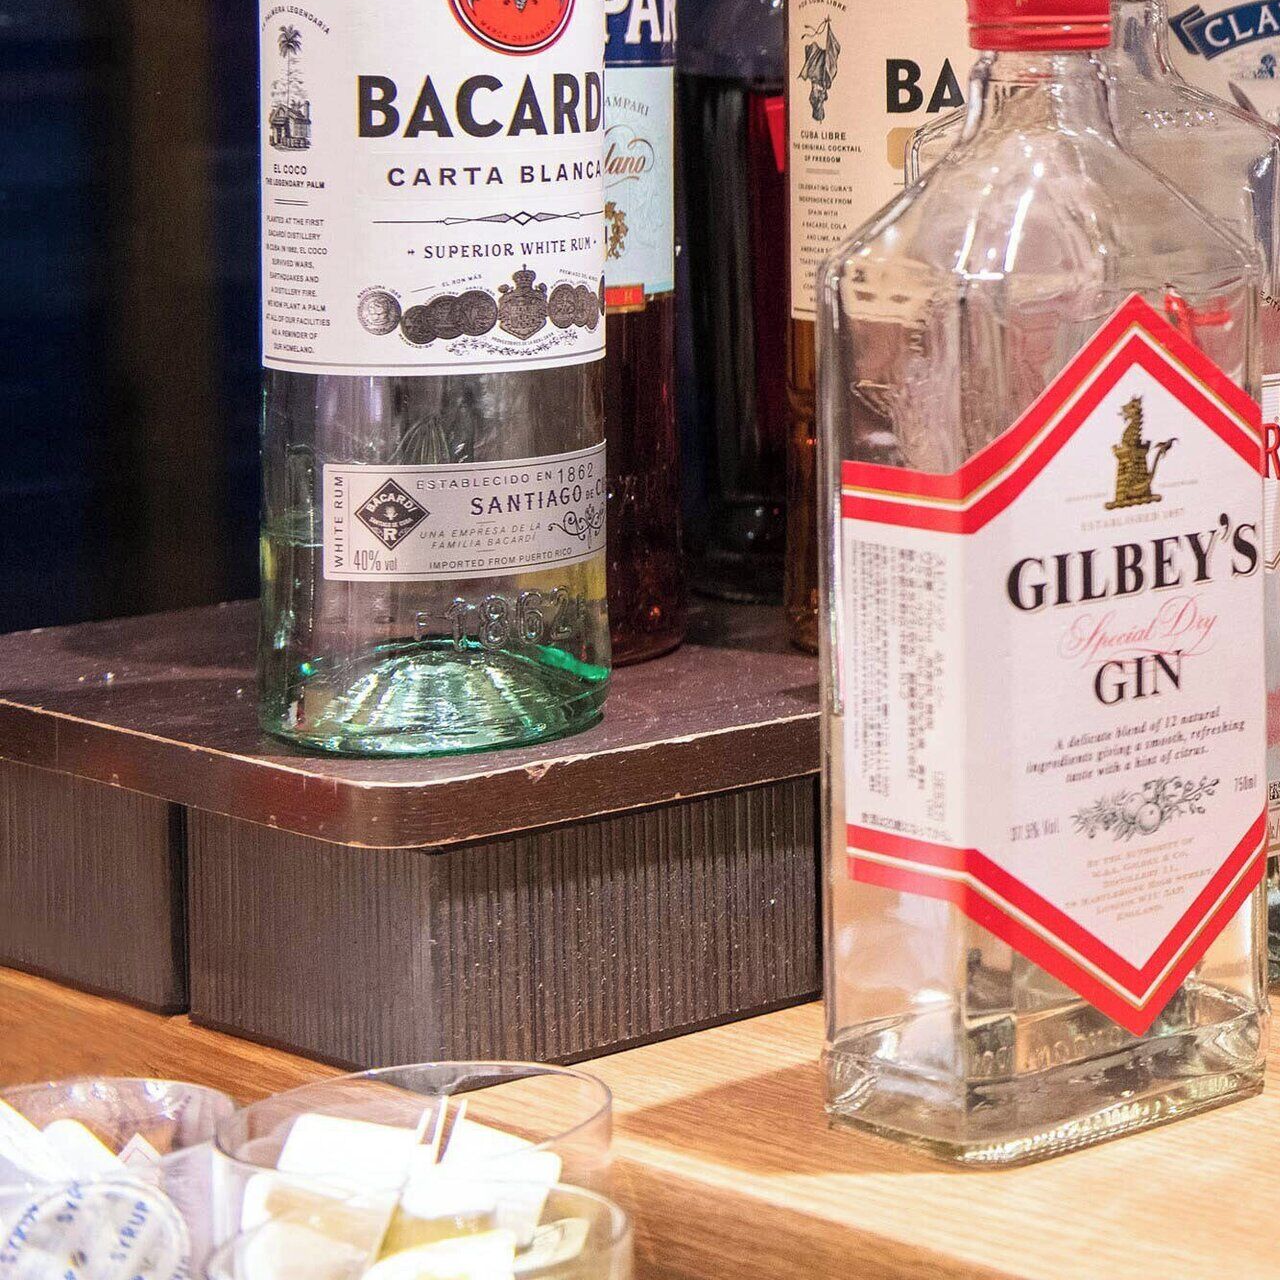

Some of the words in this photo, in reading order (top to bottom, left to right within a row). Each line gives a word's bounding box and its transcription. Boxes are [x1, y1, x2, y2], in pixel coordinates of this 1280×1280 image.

[286, 5, 331, 35] LEGENDARIA
[800, 130, 819, 140] CUBA
[821, 131, 846, 141] LIBRE
[811, 155, 841, 163] FREEDOM
[827, 144, 862, 153] COCKTAIL
[273, 163, 281, 174] EL
[283, 164, 307, 176] COCO
[387, 166, 503, 188] CARTA
[520, 159, 602, 185] BLANCA
[306, 180, 325, 189] PALM
[305, 218, 325, 227] FIRST
[830, 222, 848, 230] COLA
[307, 247, 328, 255] COCO
[424, 242, 515, 259] SUPERIOR
[520, 240, 566, 256] WHITE
[570, 236, 591, 251] RUM
[304, 275, 320, 283] AND
[307, 304, 326, 312] PALM
[296, 317, 331, 327] FACILITIES
[416, 473, 530, 490] ESTABLECIDO
[536, 471, 552, 483] EN
[557, 461, 594, 485] 1862
[334, 475, 344, 509] RUM
[469, 484, 582, 517] SANTIAGO
[383, 527, 398, 541] R
[420, 529, 445, 539] UNA
[451, 526, 507, 538] EMPRESA
[511, 524, 525, 534] DE
[529, 523, 541, 532] LA
[334, 516, 344, 569] WHITE
[430, 539, 482, 550] FAMILIA
[353, 549, 381, 571] 40%
[384, 557, 398, 571] vol
[429, 558, 485, 570] IMPORTED
[488, 555, 516, 567] FROM
[518, 550, 553, 565] PUERTO
[554, 547, 573, 560] RICO
[1007, 513, 1259, 612] GILBEY'S
[1061, 609, 1154, 668] Special
[1153, 594, 1219, 654] Dry
[1094, 650, 1184, 706] GIN
[1115, 724, 1146, 739] blend
[1149, 718, 1162, 732] of
[1164, 717, 1177, 728] 12
[1180, 707, 1220, 726] natural
[1096, 744, 1132, 762] giving
[1190, 720, 1246, 740] refreshing
[1096, 764, 1121, 777] with
[1135, 755, 1157, 769] hint
[1159, 750, 1173, 765] of
